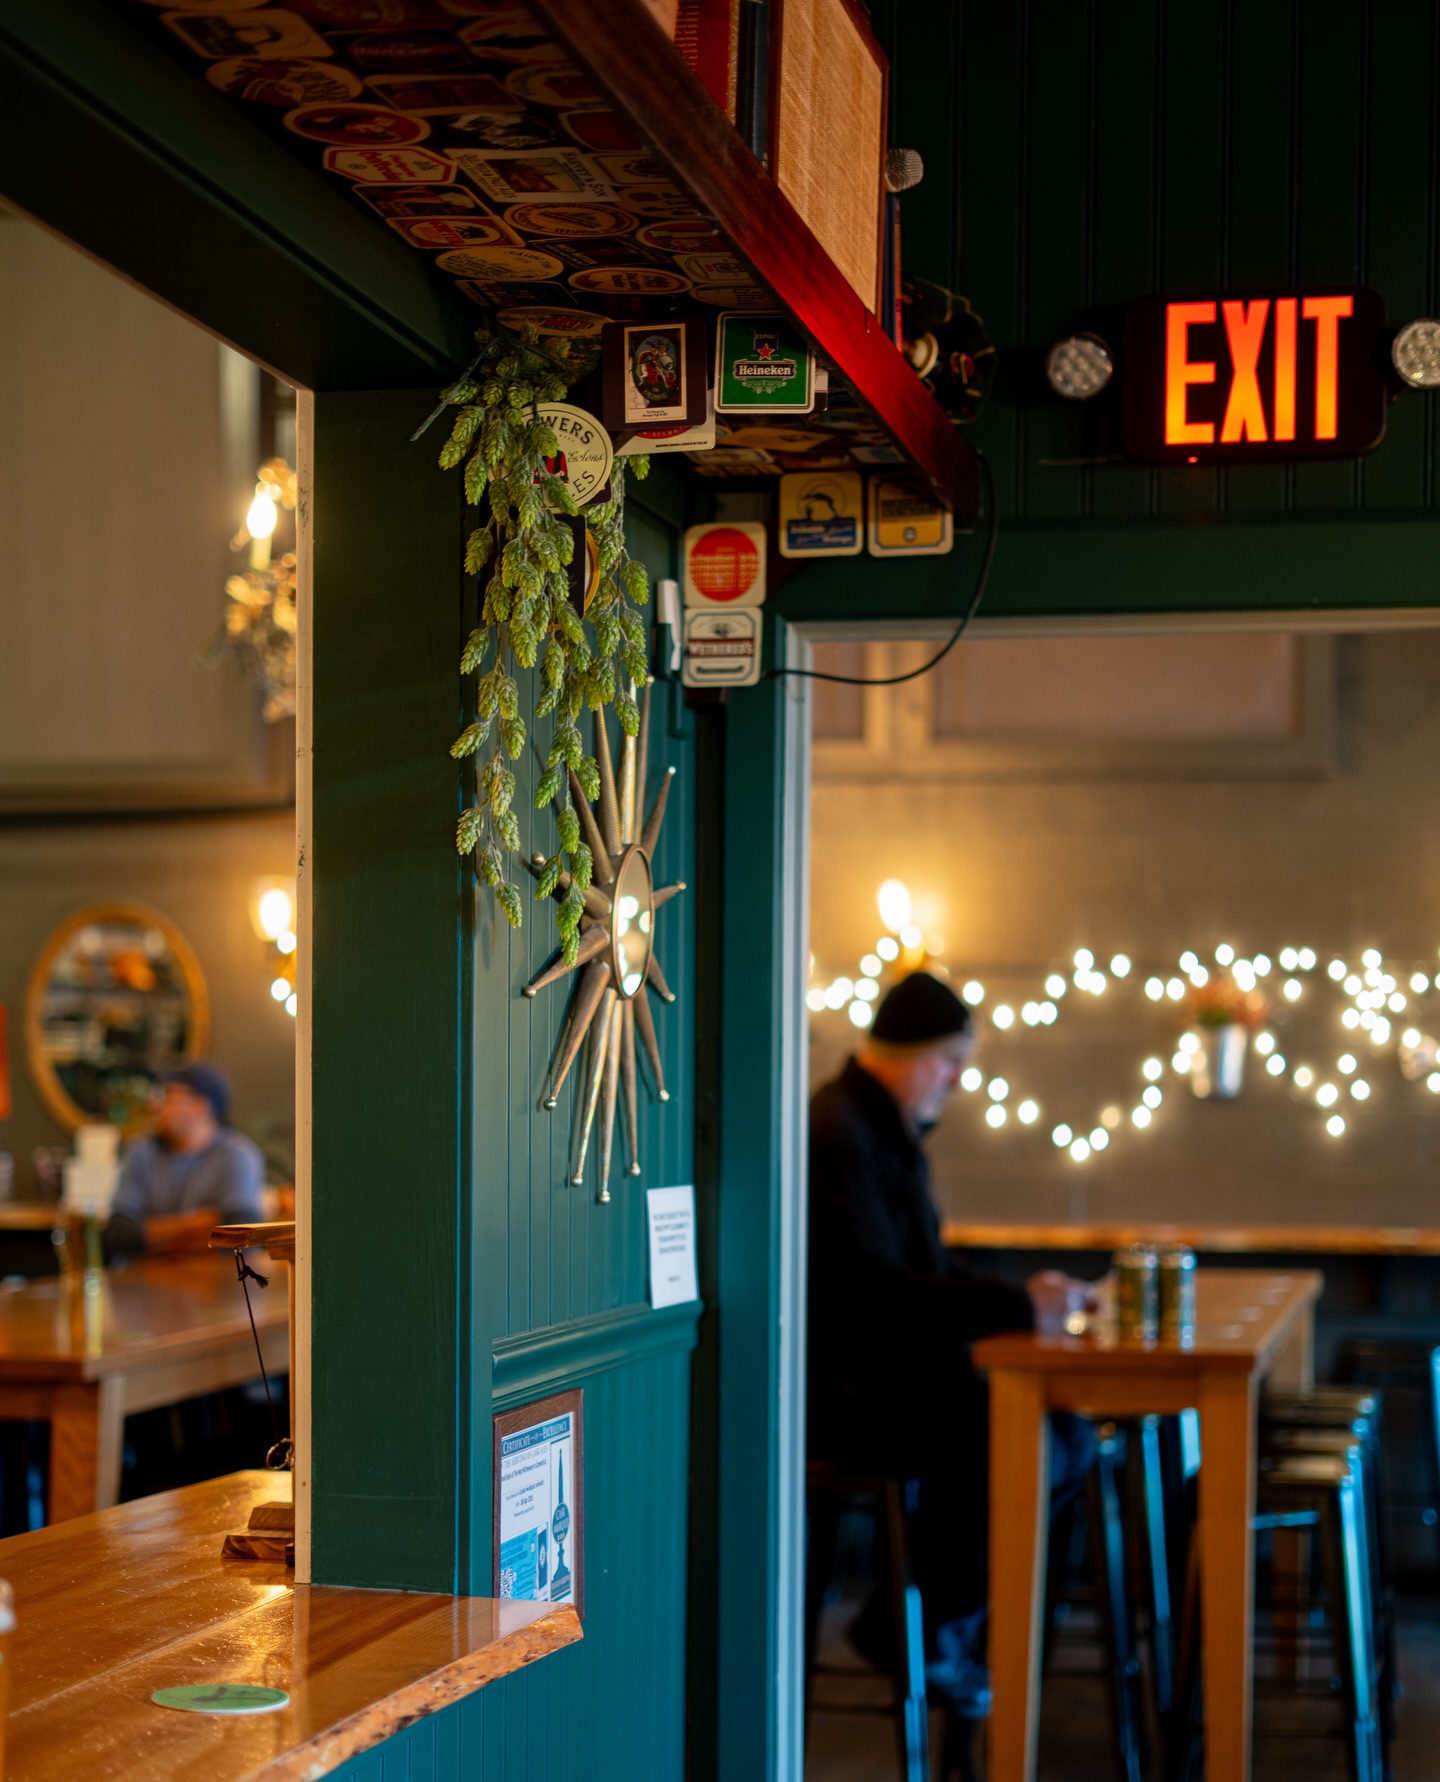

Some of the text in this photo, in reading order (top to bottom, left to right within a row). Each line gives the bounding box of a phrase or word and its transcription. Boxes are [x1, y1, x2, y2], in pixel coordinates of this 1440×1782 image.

[560, 152, 592, 176] HARVEY
[588, 184, 608, 196] SON
[738, 365, 792, 375] Heineken
[1164, 295, 1354, 445] EXIT
[502, 1435, 530, 1454] CERTIFICATE
[543, 1421, 566, 1440] EXCELLENCE
